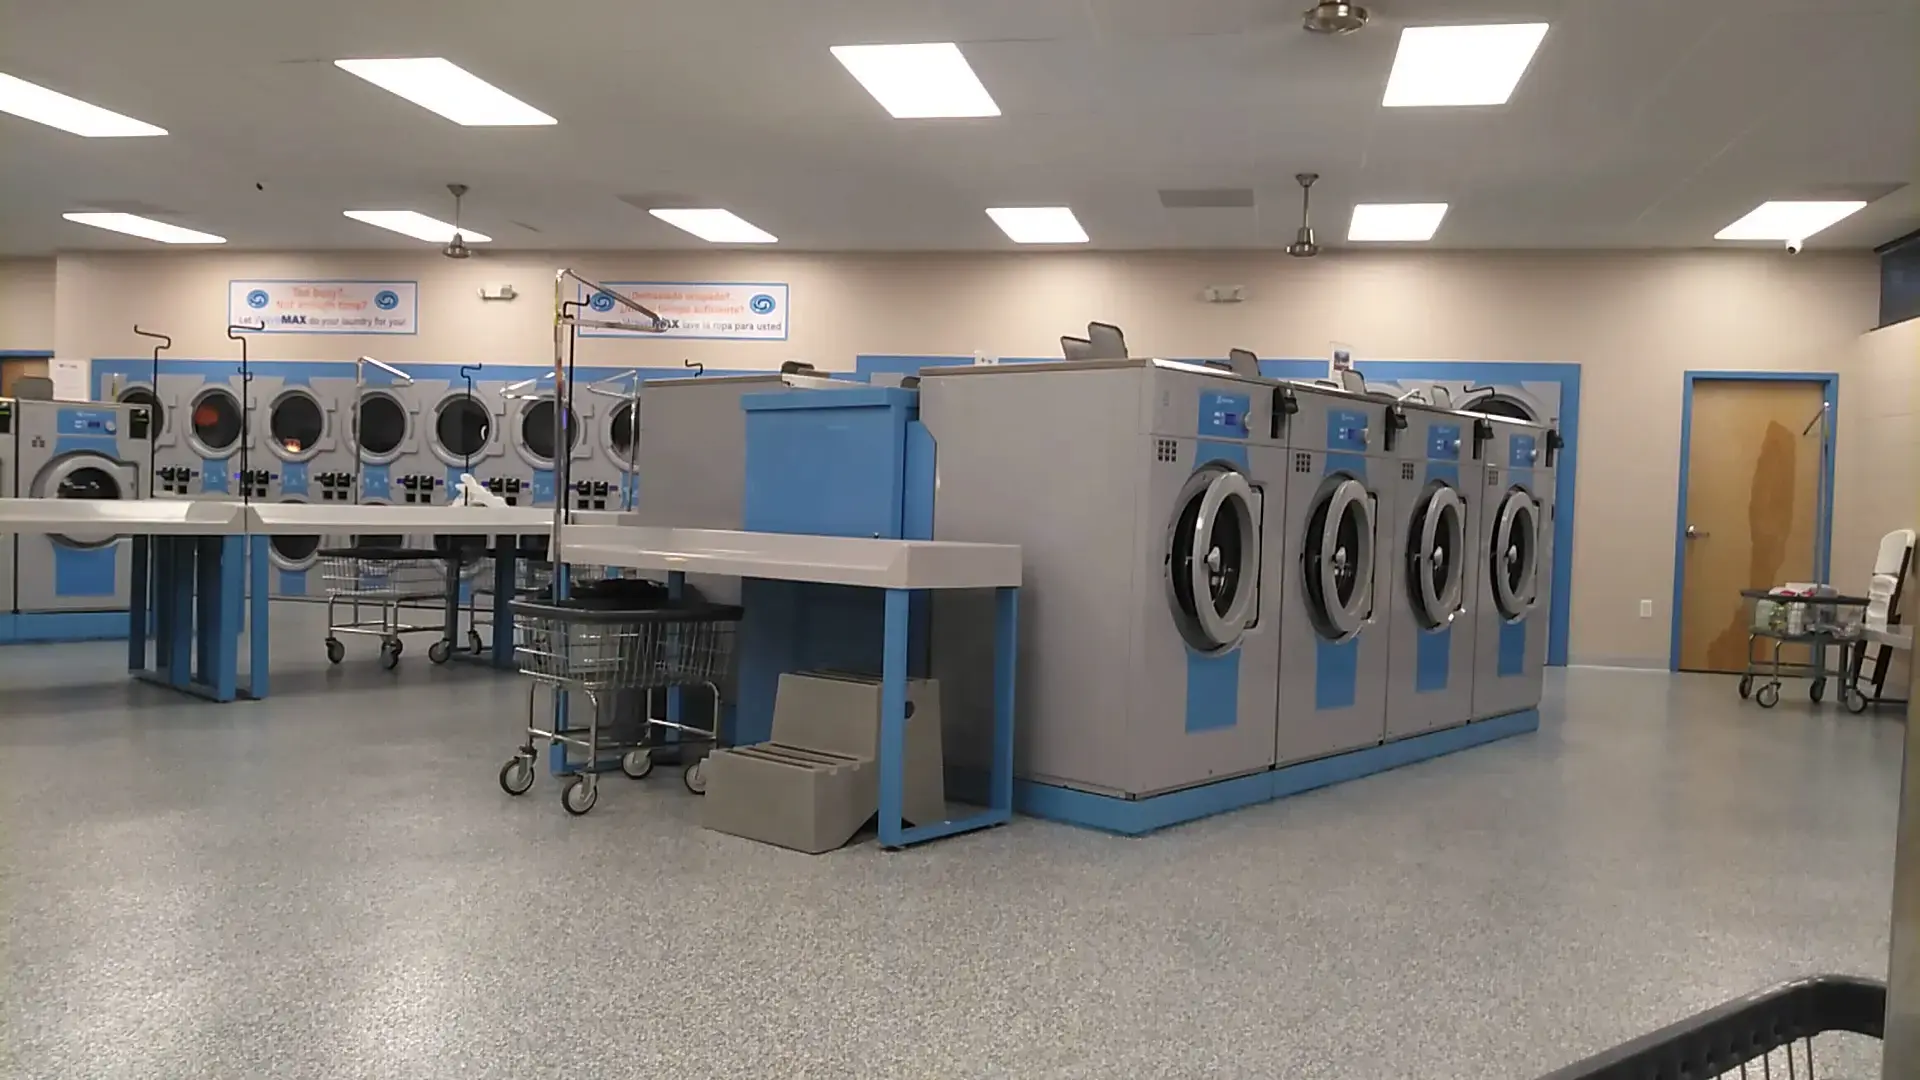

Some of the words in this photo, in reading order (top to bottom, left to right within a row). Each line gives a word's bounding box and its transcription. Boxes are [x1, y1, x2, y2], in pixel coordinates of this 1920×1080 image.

[374, 316, 386, 326] for
[713, 323, 732, 332] ropa
[734, 323, 754, 333] para
[757, 321, 782, 331] usted
